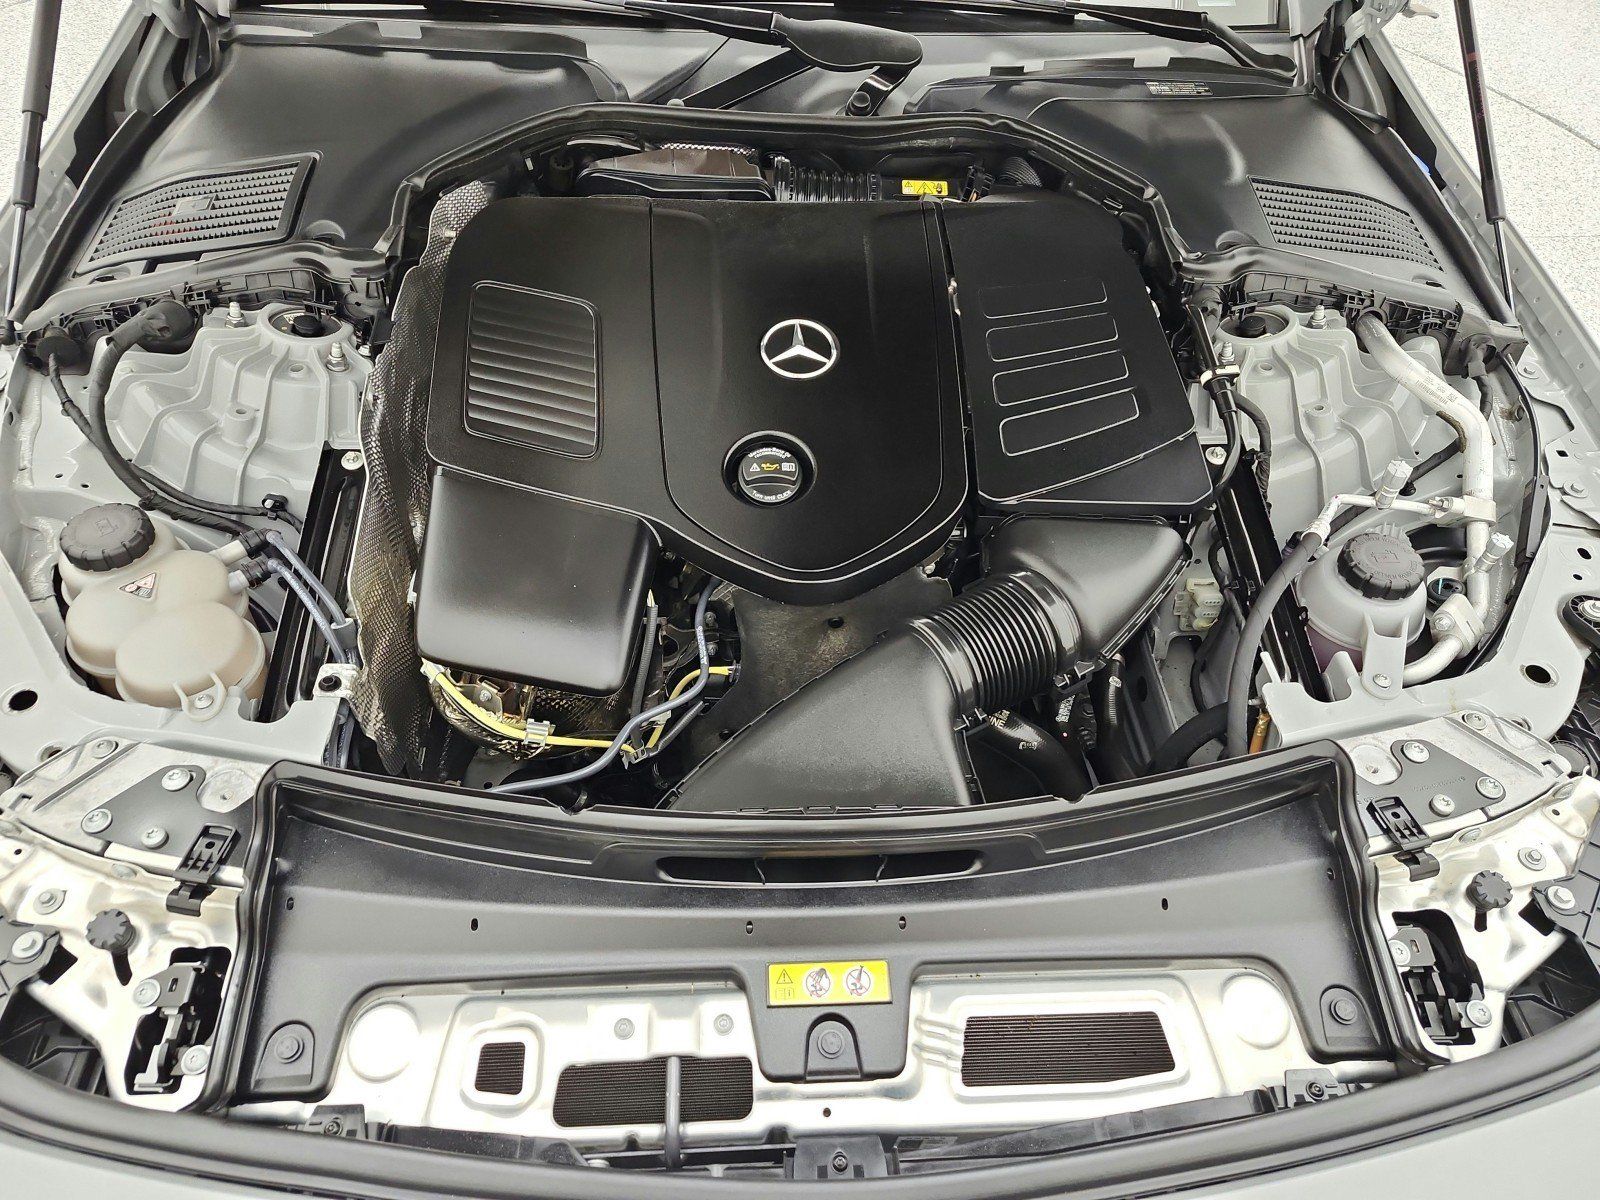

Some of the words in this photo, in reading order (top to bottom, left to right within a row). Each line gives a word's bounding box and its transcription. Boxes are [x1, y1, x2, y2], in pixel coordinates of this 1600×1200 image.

[747, 447, 785, 458] Mercedes-Benz
[752, 490, 763, 499] Turn
[776, 490, 792, 499] CLICK
